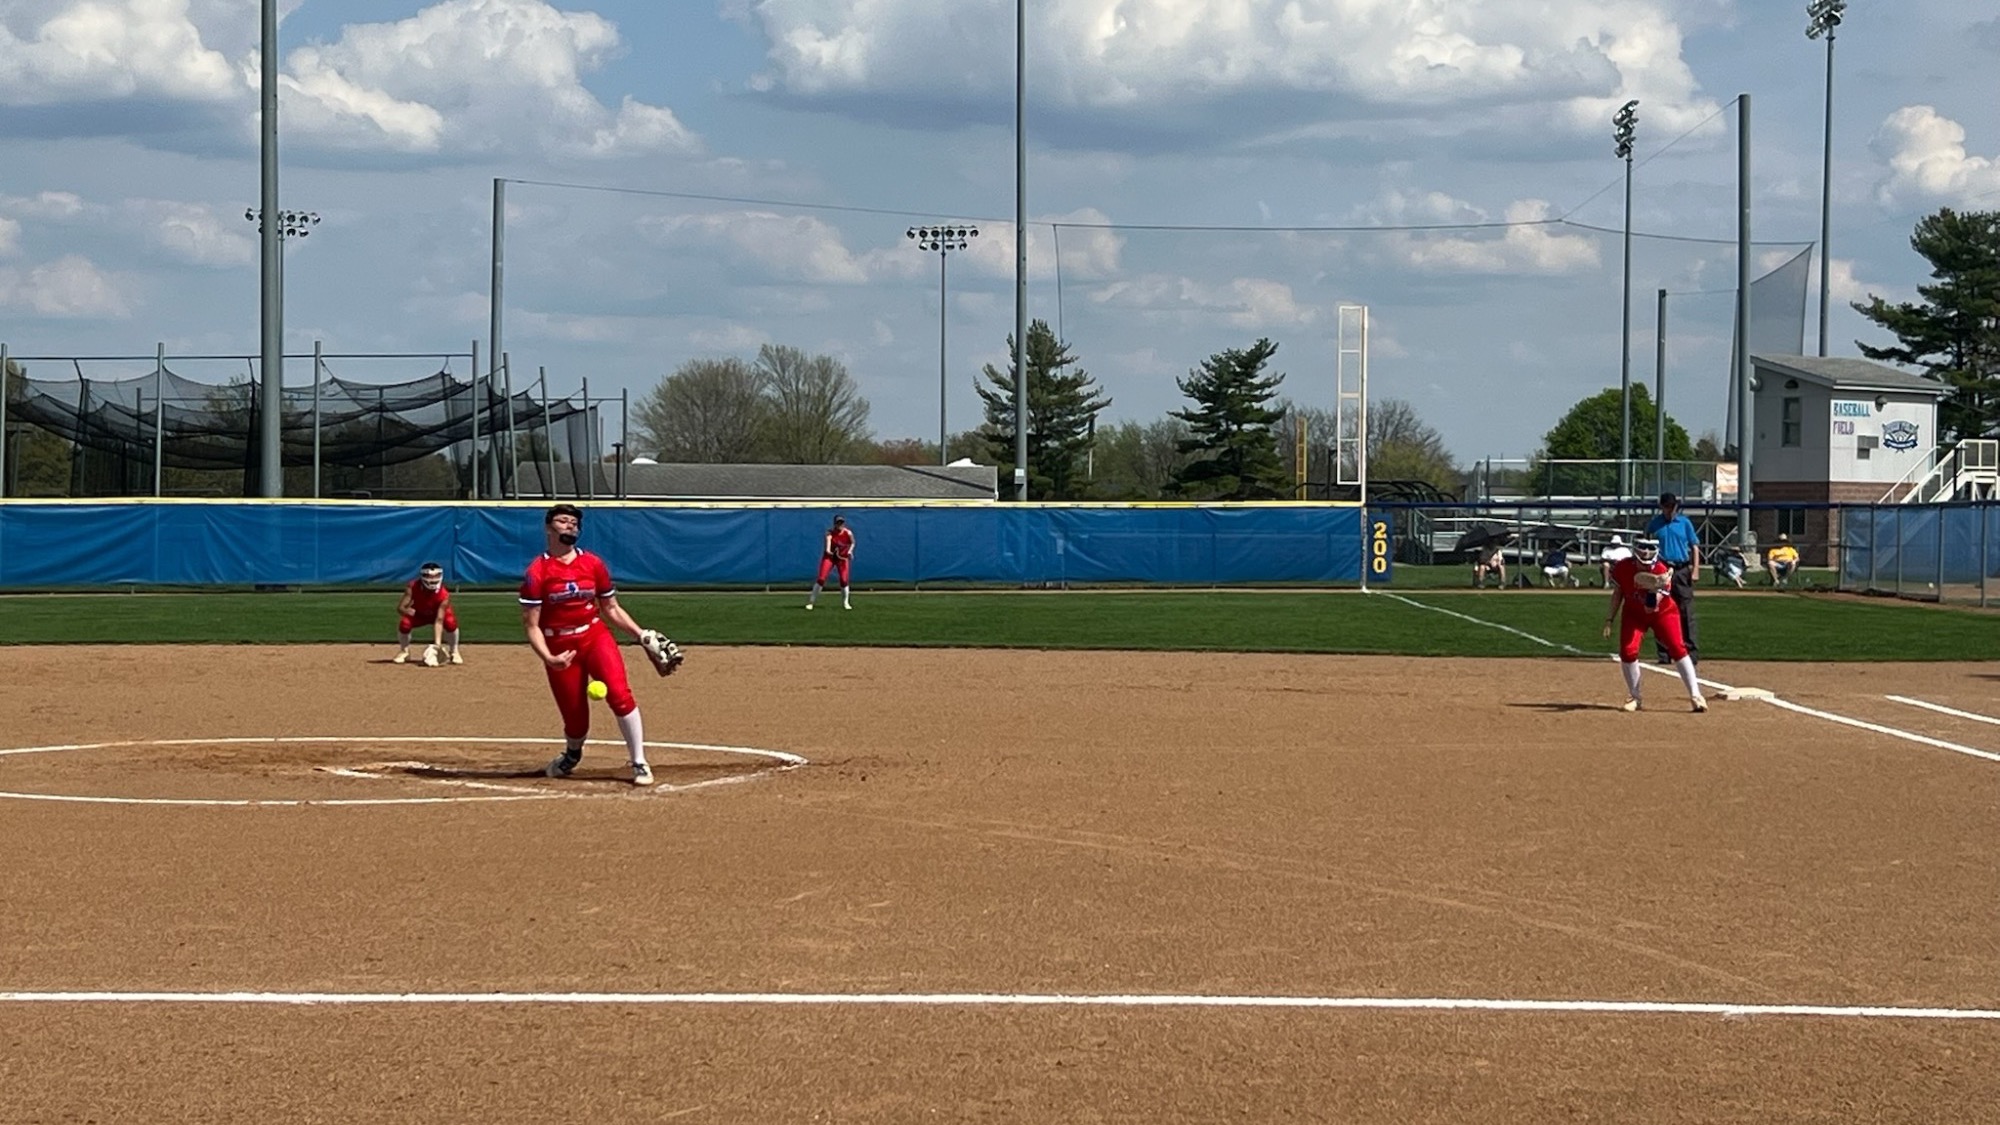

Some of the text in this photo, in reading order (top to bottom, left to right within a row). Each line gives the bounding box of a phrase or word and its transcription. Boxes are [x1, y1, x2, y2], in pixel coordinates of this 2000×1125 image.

[1833, 402, 1870, 417] BASEBALL
[1833, 421, 1855, 435] FIELD
[1373, 521, 1387, 574] 200
